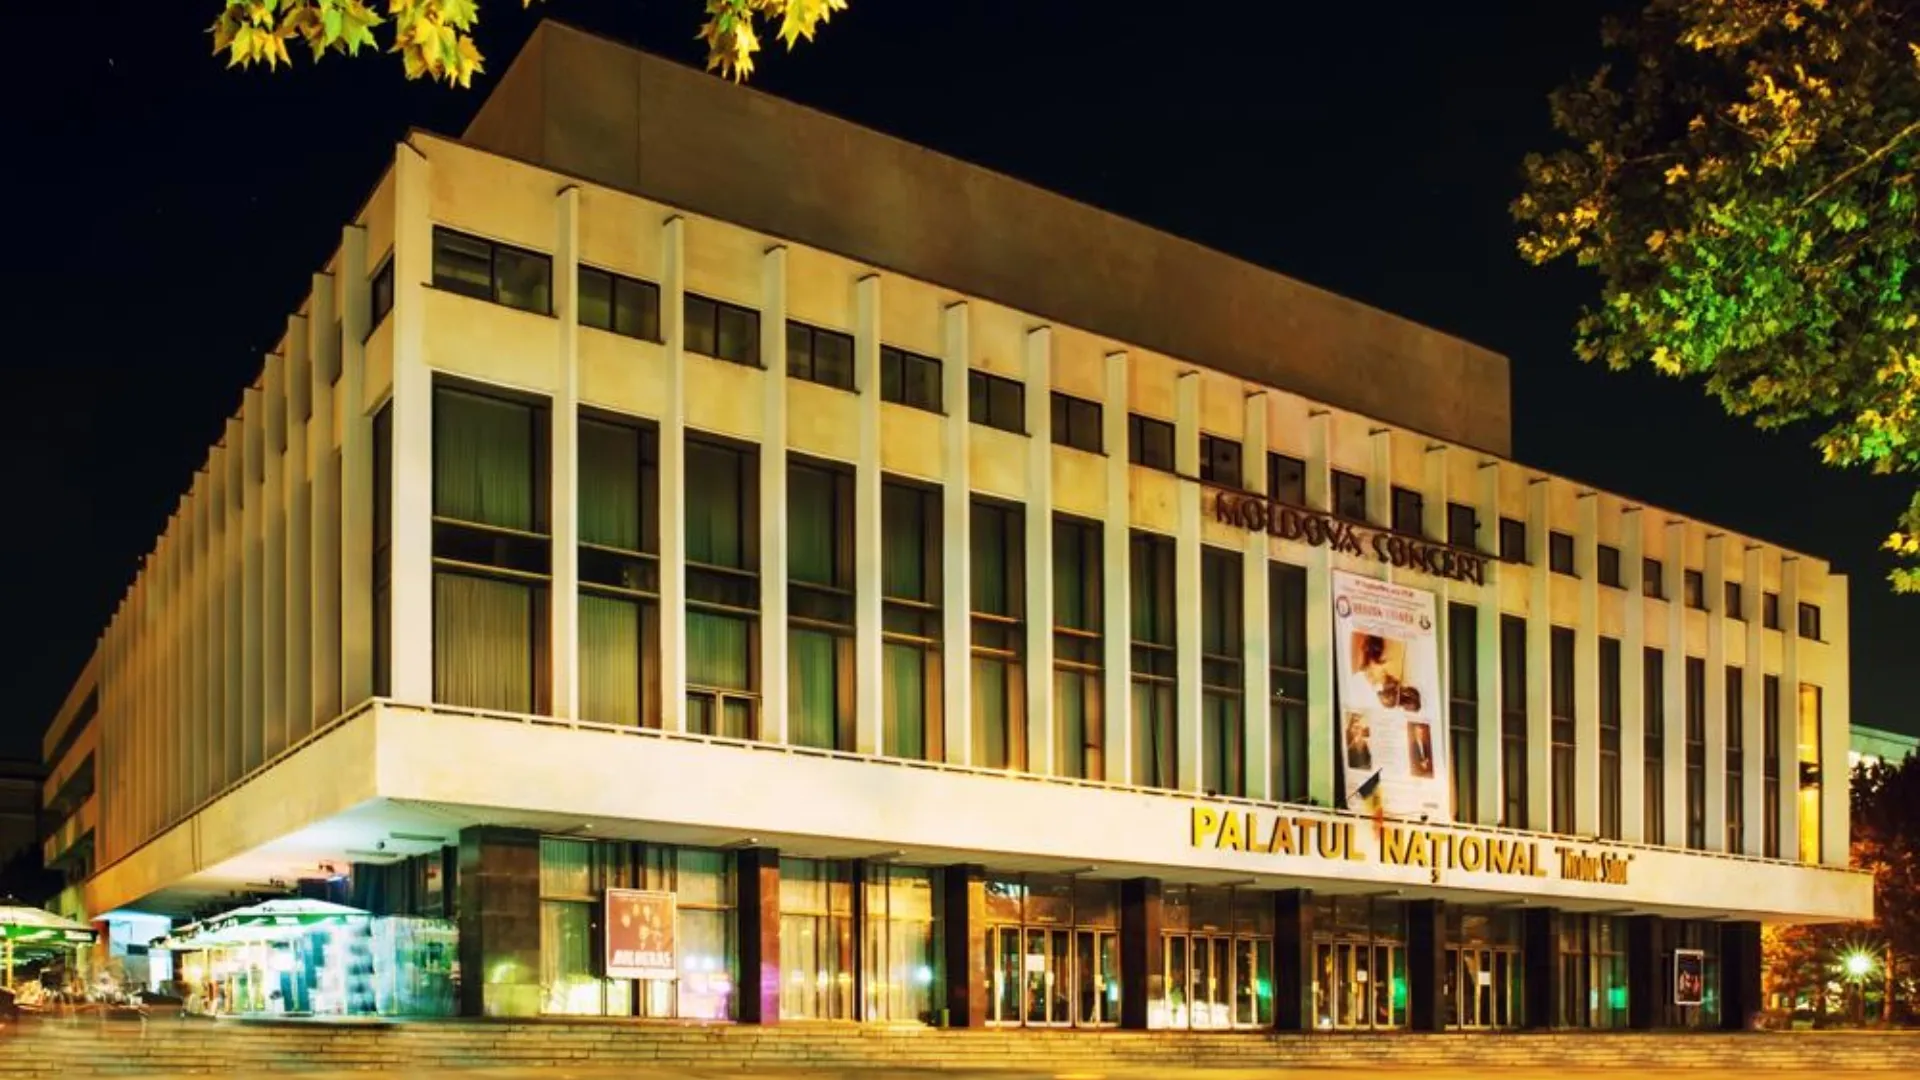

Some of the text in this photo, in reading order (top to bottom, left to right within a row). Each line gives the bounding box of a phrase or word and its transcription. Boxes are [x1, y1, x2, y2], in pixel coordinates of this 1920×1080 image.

[1216, 492, 1488, 586] MOLDOVA CONCERT
[1190, 806, 1366, 861] PALATUL
